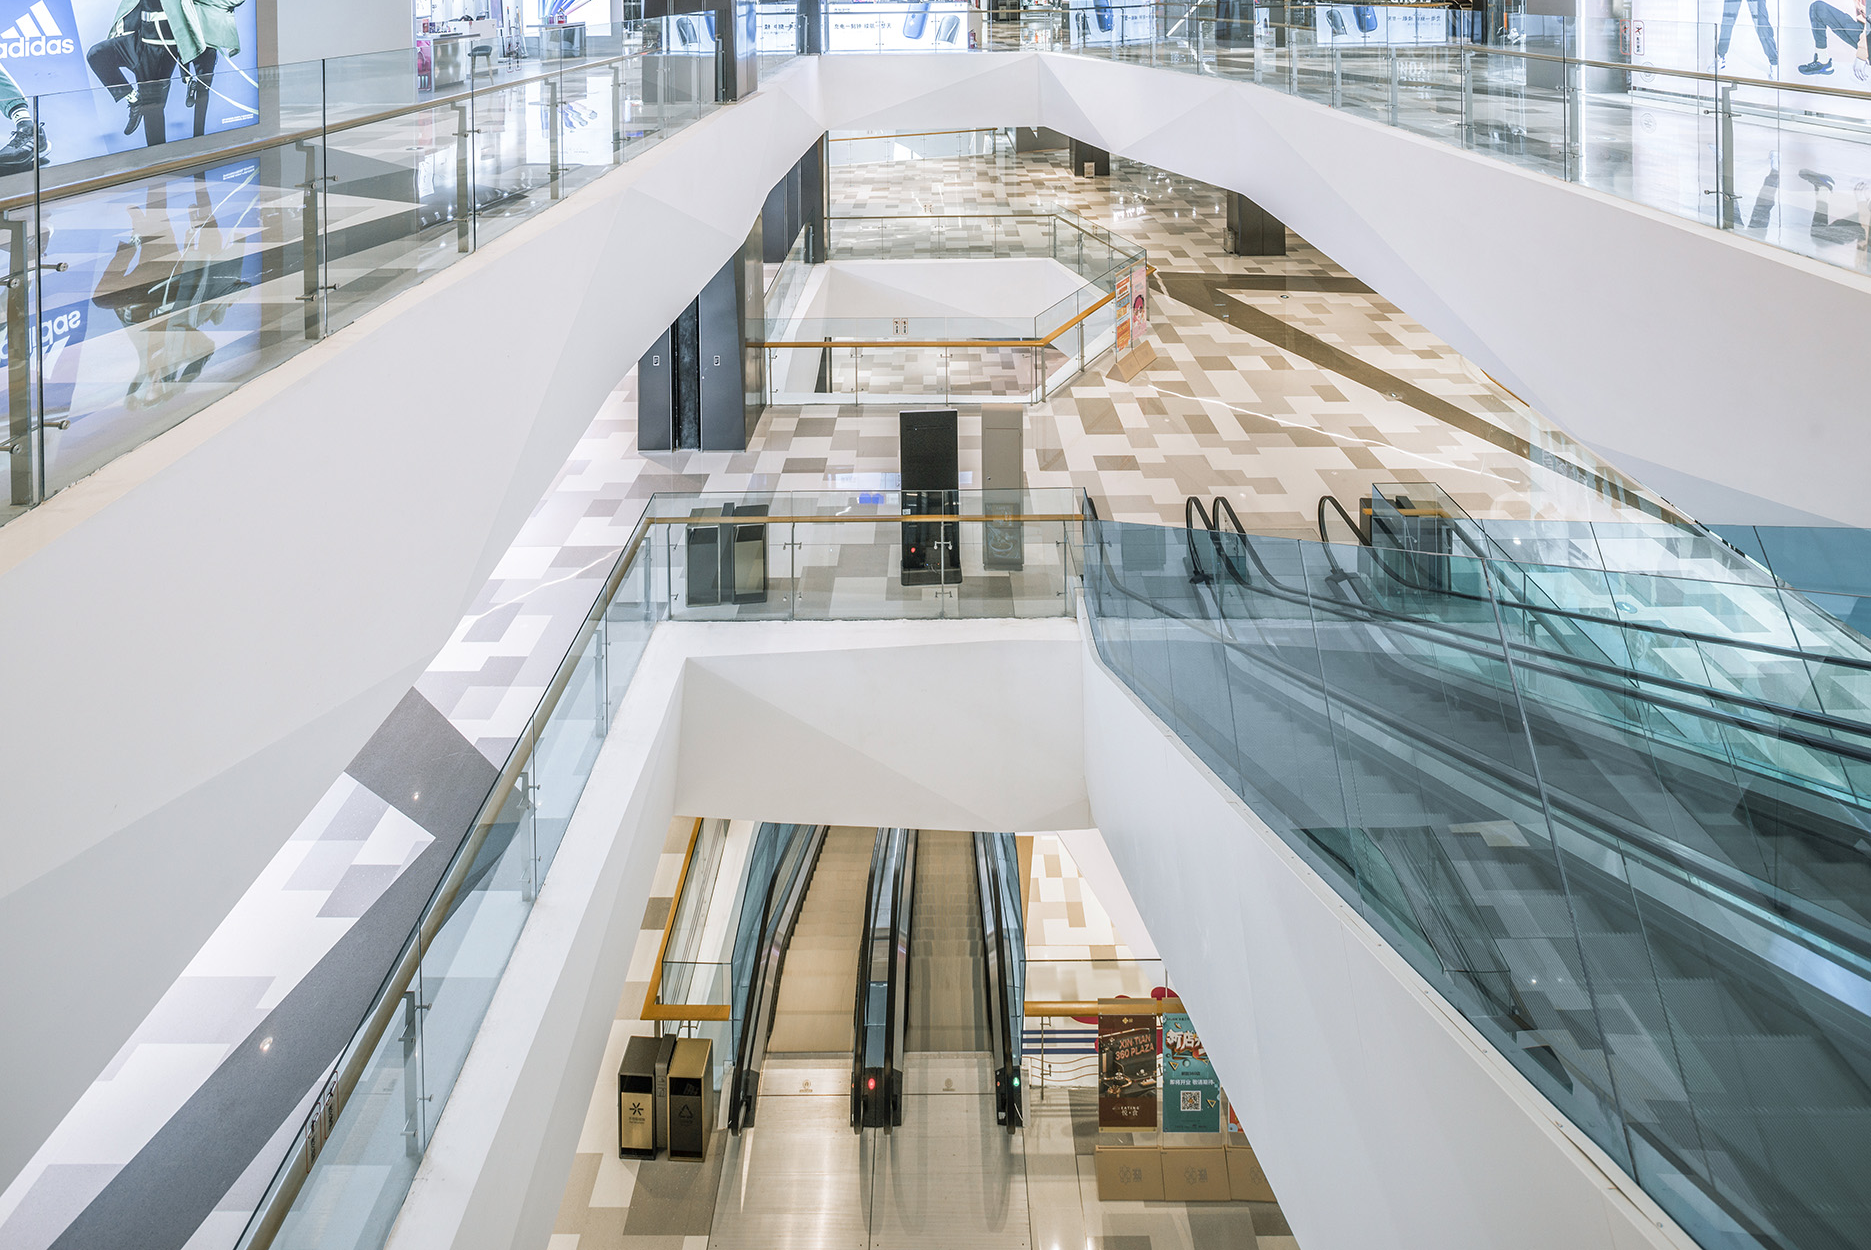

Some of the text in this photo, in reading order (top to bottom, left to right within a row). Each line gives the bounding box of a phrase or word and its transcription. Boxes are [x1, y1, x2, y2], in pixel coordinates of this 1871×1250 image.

[1119, 1033, 1151, 1049] XIN TIAN
[1115, 1043, 1154, 1061] 360 PLAZA
